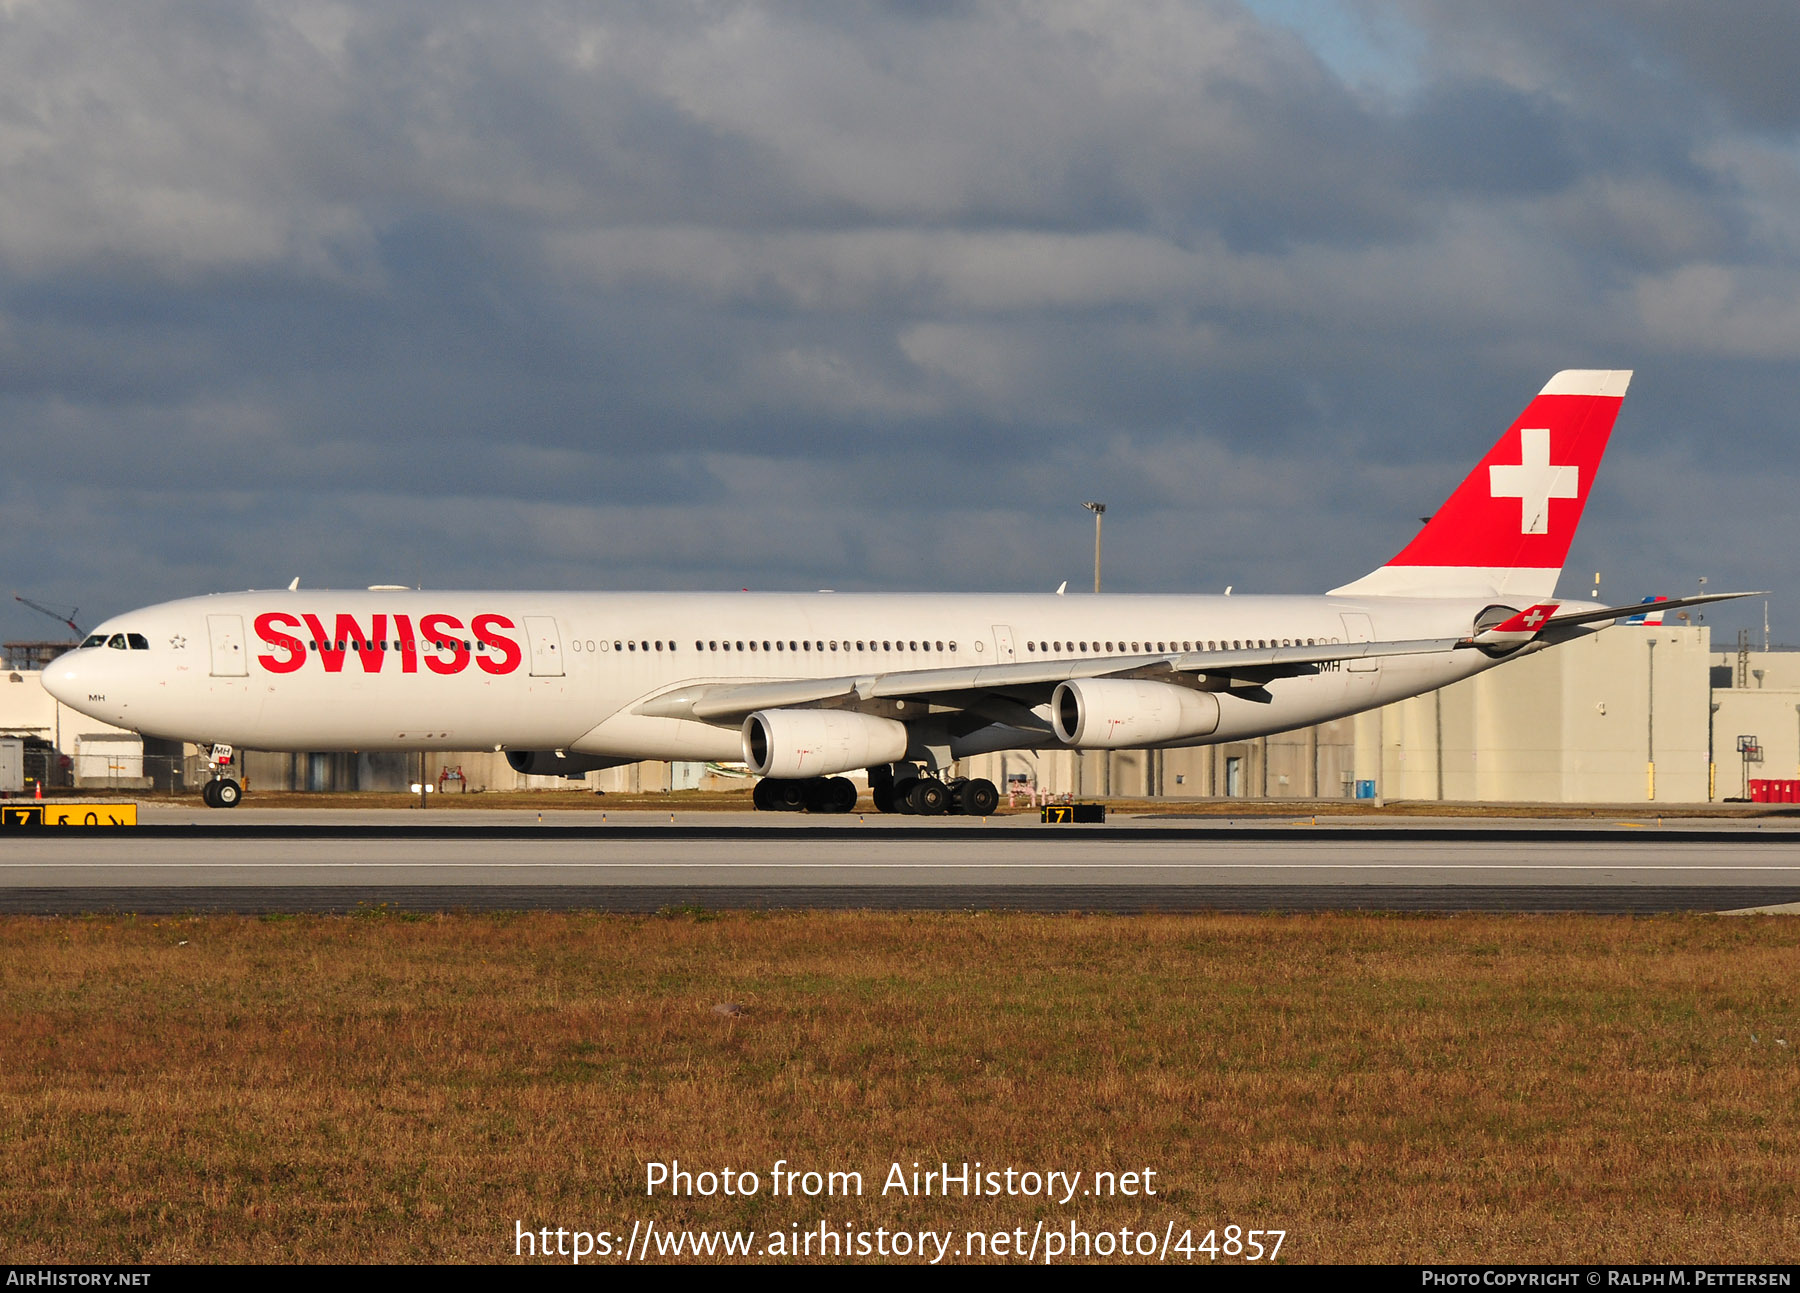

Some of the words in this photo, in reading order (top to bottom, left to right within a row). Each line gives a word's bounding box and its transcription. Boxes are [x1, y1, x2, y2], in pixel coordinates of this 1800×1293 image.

[254, 612, 522, 675] SWISS
[88, 694, 106, 702] MH
[213, 746, 231, 755] MH
